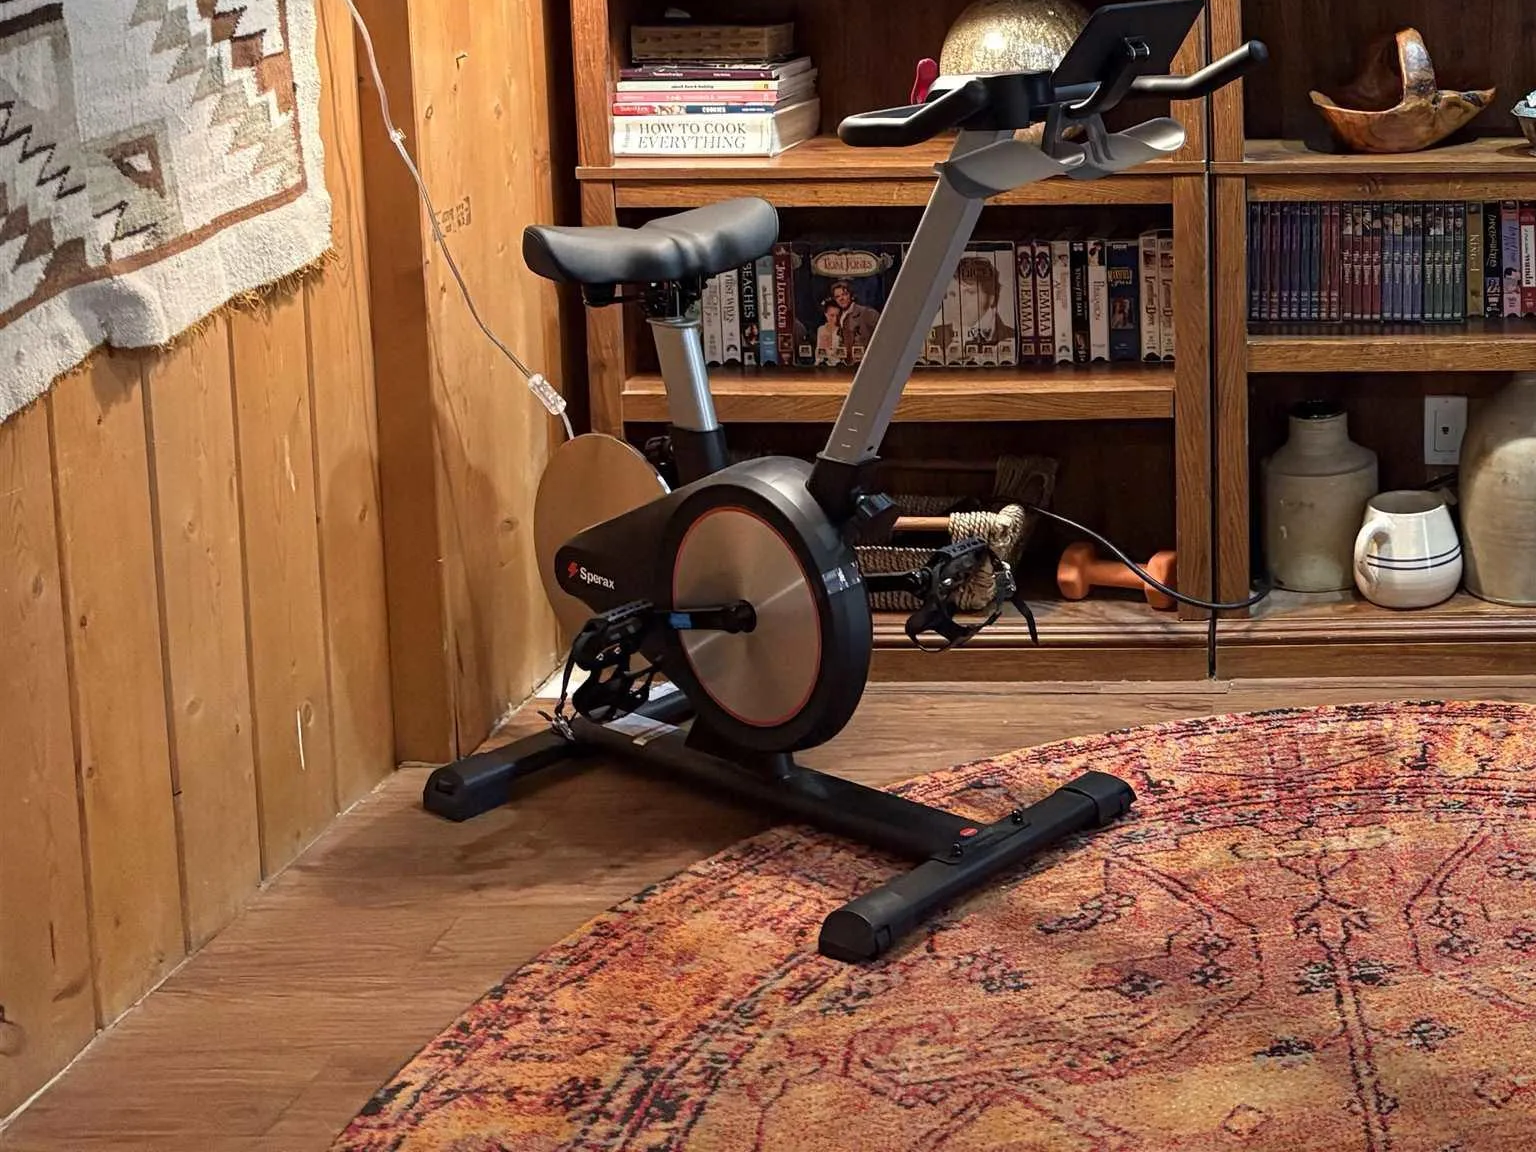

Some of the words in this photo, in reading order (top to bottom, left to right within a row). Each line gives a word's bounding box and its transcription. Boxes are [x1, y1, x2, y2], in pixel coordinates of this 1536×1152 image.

[640, 123, 674, 135] HOW
[679, 123, 700, 135] TO
[704, 123, 747, 134] COOK
[638, 136, 746, 150] EVERYTHING
[775, 264, 786, 281] JOY
[1525, 254, 1533, 285] wanda
[743, 263, 755, 318] BEACHES
[777, 282, 787, 304] LUCK
[778, 304, 788, 328] CLUB
[1020, 289, 1032, 332] EMMA
[1039, 289, 1051, 332] EMMA
[579, 567, 615, 589] Sperax
